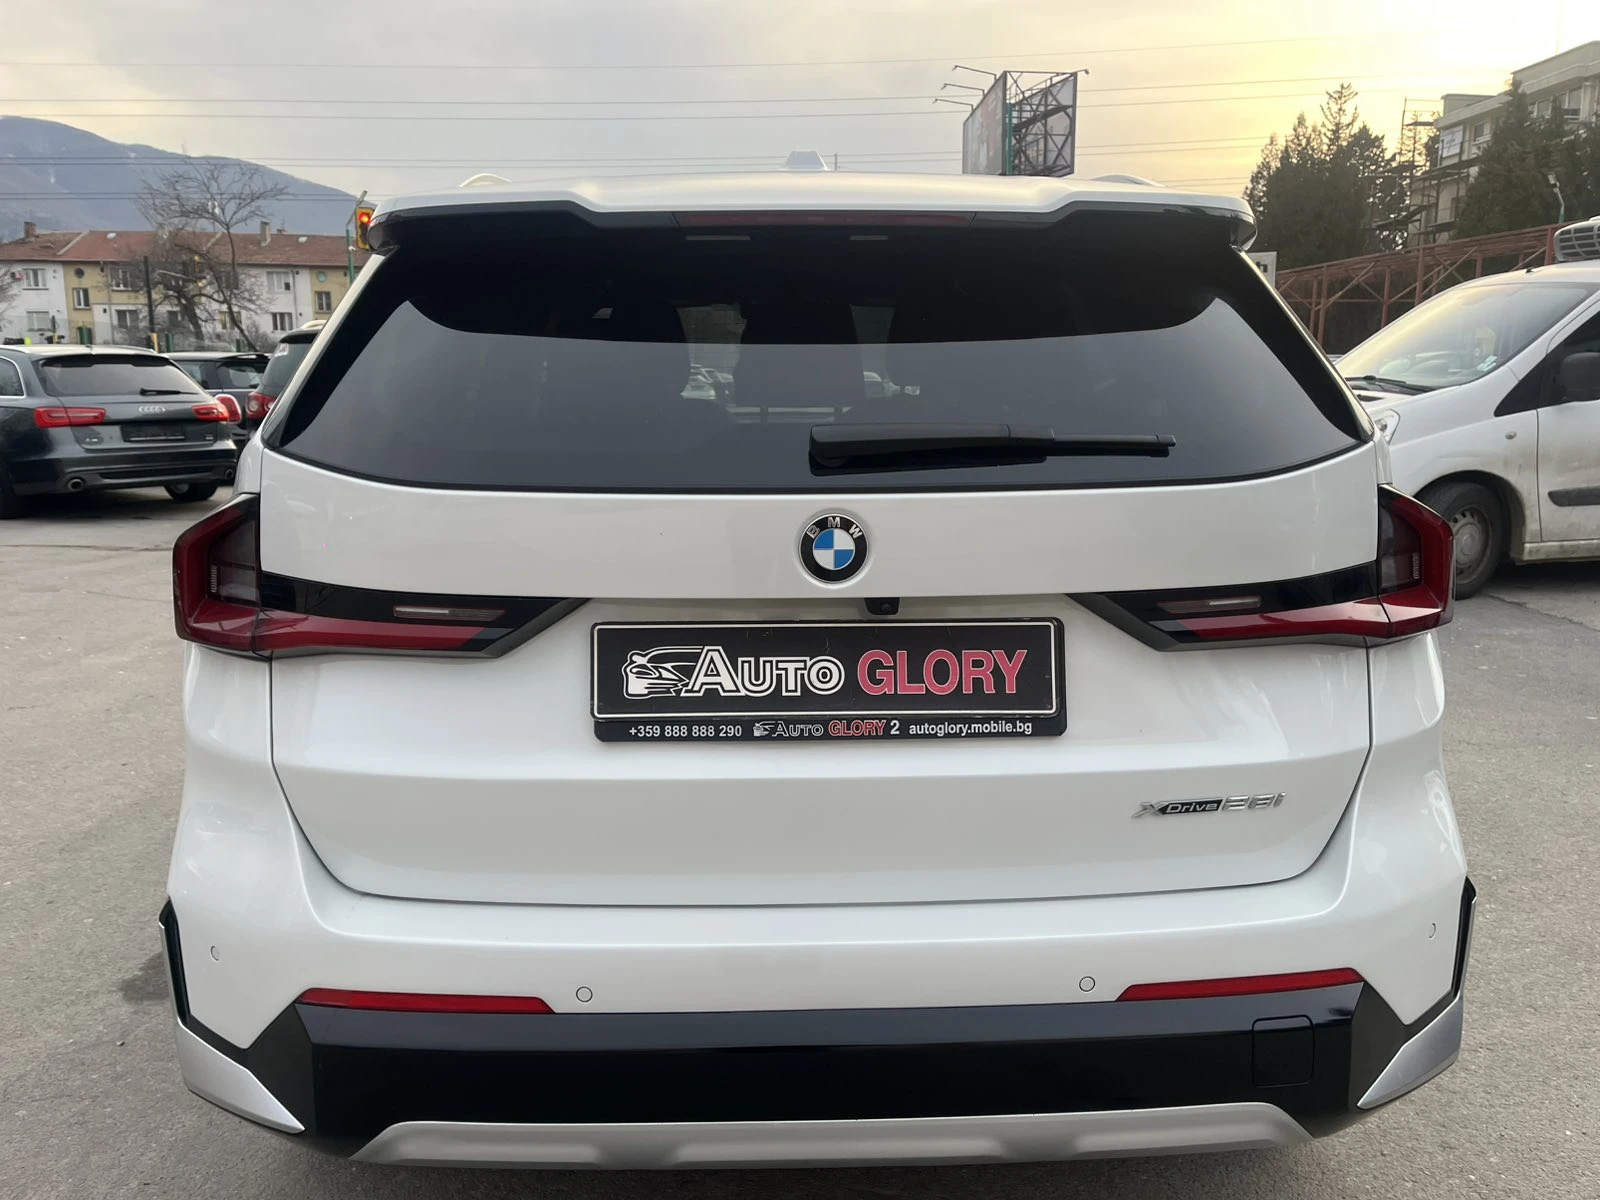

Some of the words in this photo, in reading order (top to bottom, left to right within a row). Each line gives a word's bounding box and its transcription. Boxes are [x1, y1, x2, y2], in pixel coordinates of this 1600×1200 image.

[806, 516, 863, 539] BMW
[680, 645, 845, 698] AUTO
[857, 649, 1028, 696] GLORY
[629, 725, 660, 737] +359
[664, 725, 688, 737] 888
[691, 725, 715, 737] 888
[719, 725, 742, 737] 290
[828, 719, 887, 737] GLORY
[890, 720, 900, 735] 2
[908, 720, 1033, 737] autoglory.mobile.bg
